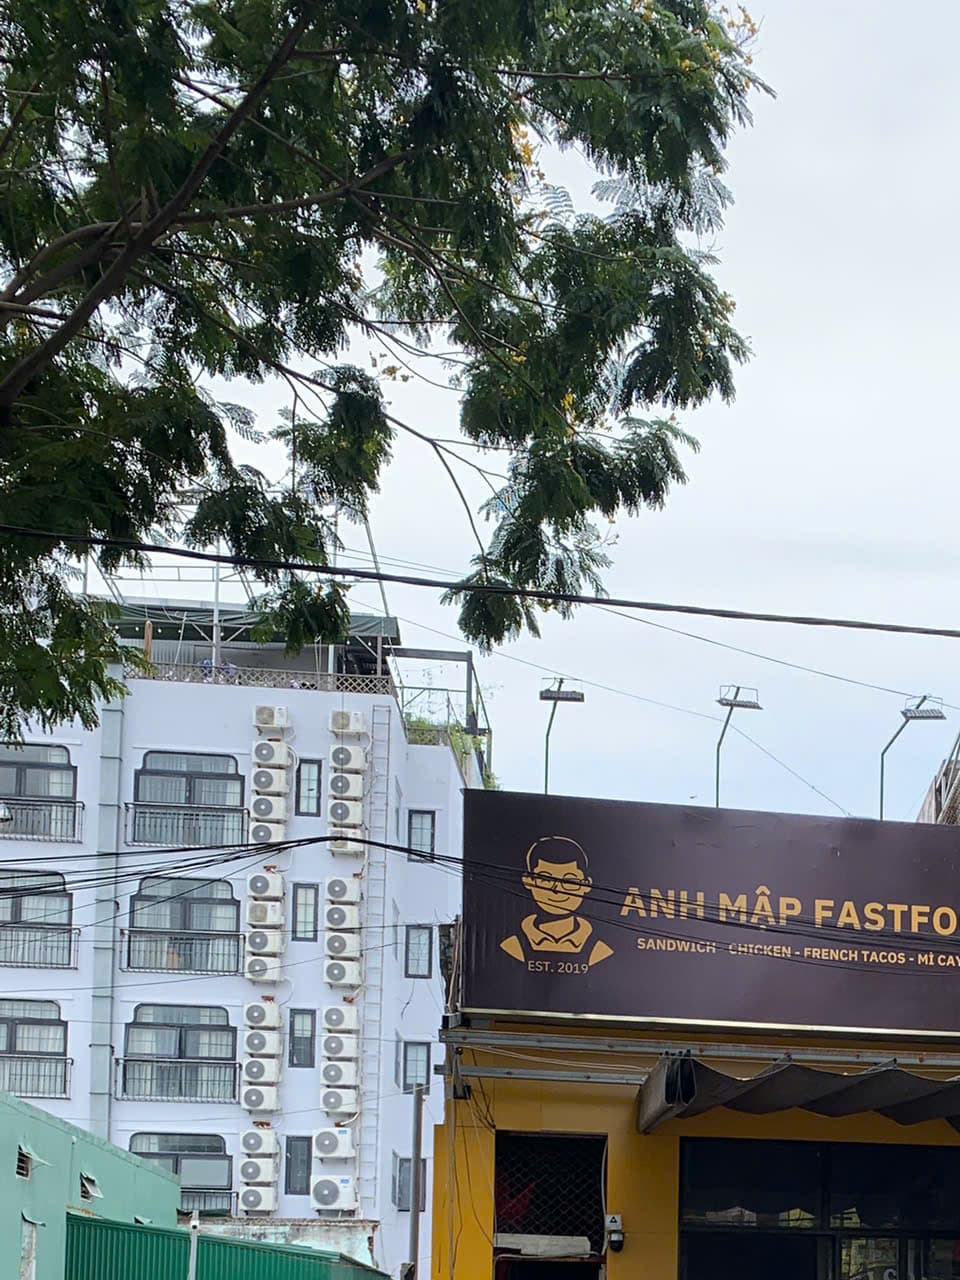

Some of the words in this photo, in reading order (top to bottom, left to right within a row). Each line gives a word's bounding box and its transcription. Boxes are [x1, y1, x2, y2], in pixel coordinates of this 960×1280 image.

[619, 887, 705, 920] ANH
[719, 885, 802, 931] MẬP
[637, 938, 716, 954] SANDWICH
[728, 942, 791, 958] CHICKEN
[804, 947, 858, 961] FRENCH
[861, 950, 906, 964] TACOS
[528, 960, 554, 973] EST.
[557, 962, 589, 974] 2019
